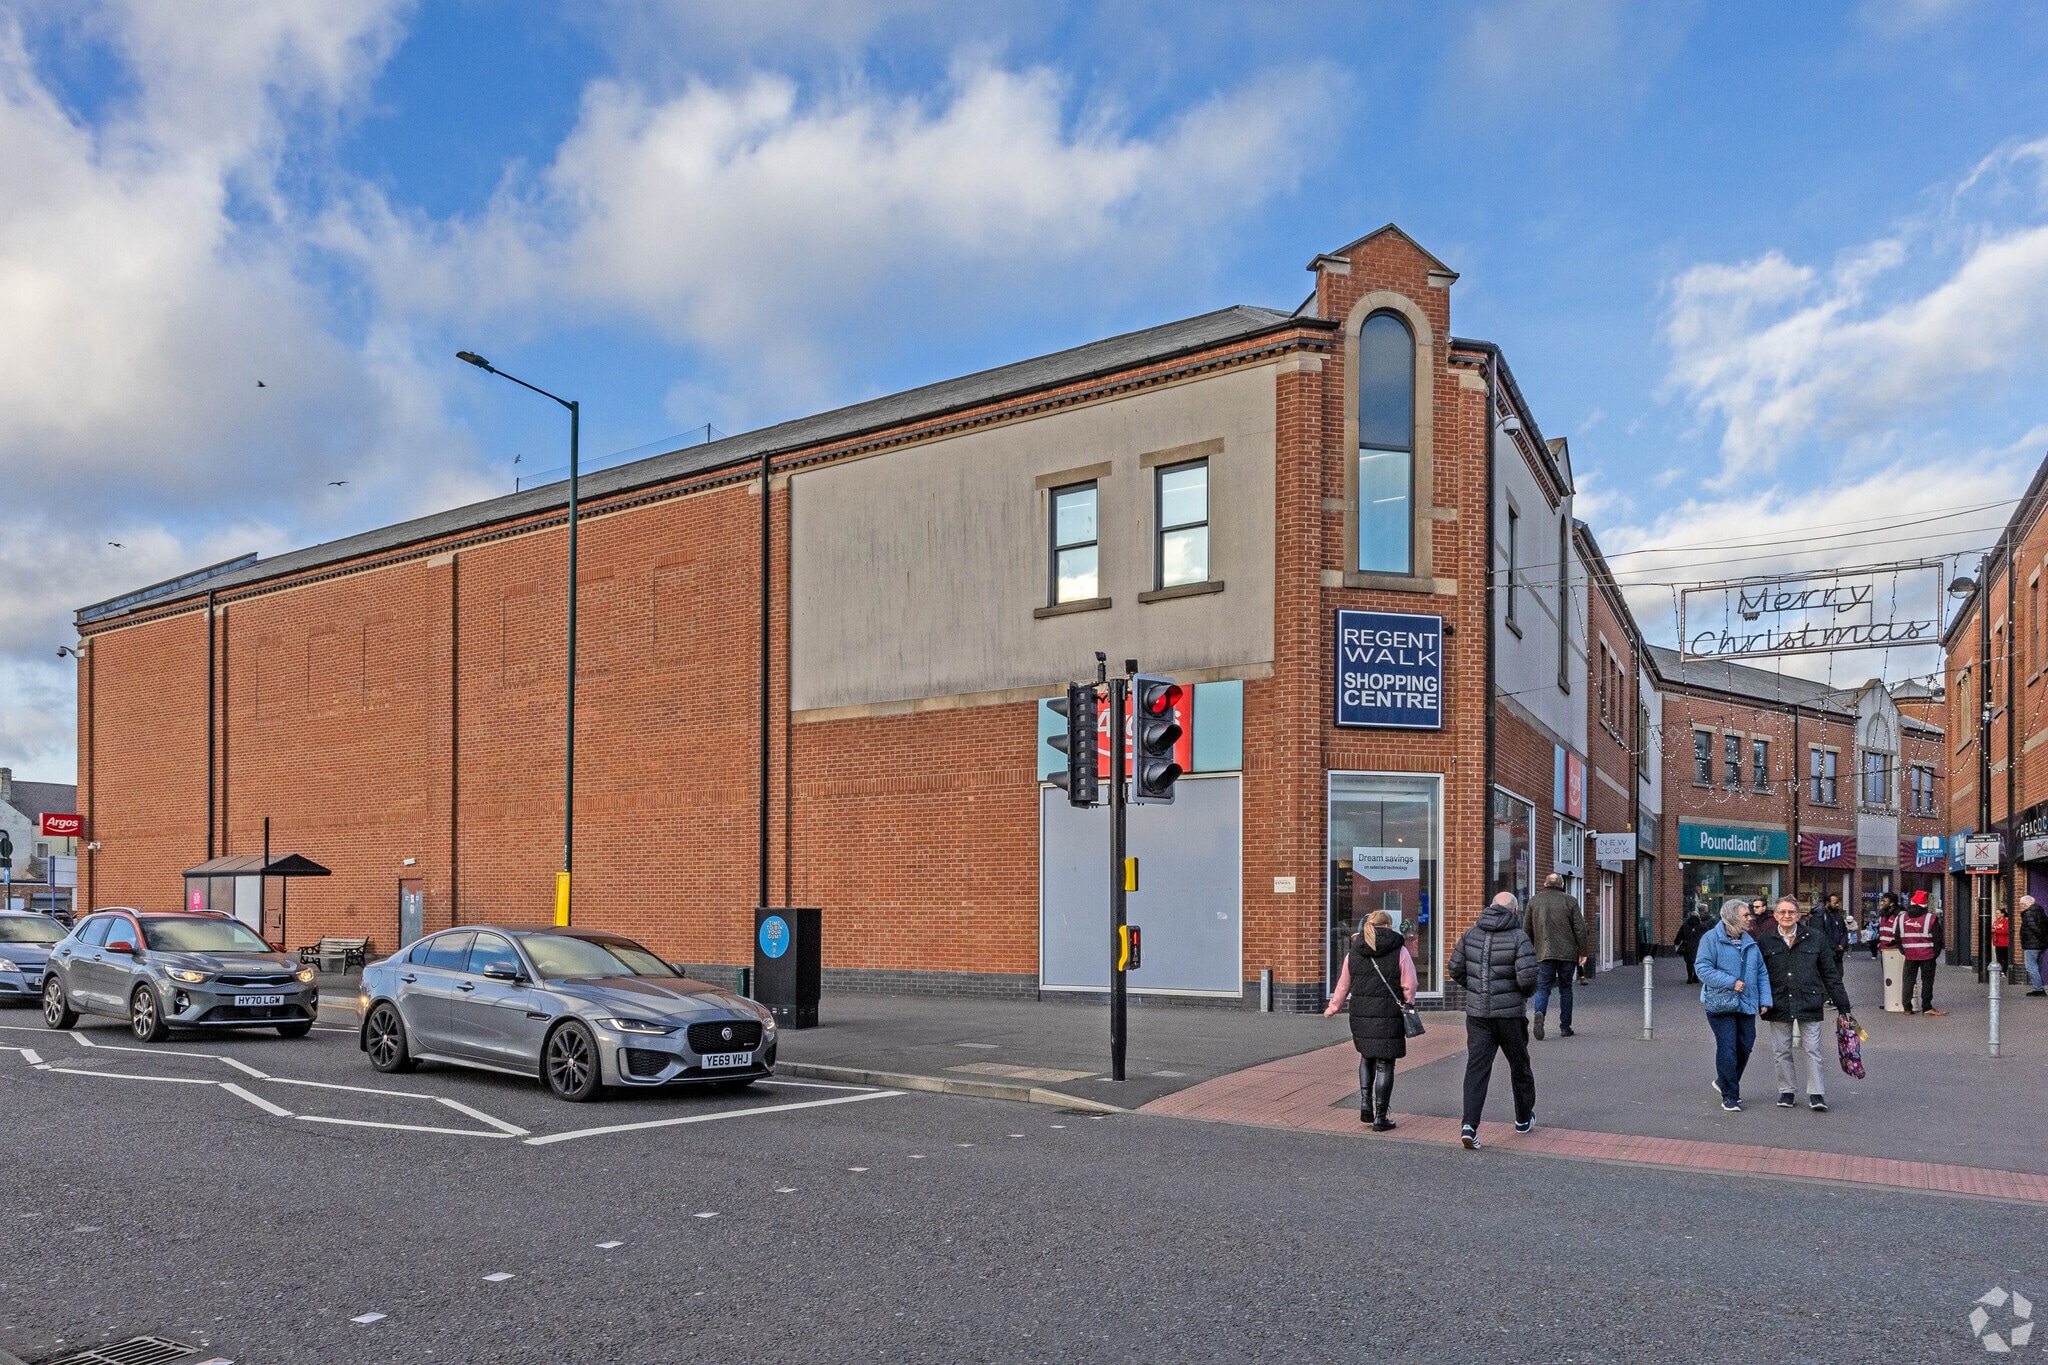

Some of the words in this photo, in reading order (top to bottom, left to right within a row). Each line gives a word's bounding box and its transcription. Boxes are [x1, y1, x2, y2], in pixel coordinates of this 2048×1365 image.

[1737, 584, 1871, 614] Merry
[1344, 628, 1438, 649] REGENT
[1691, 620, 1931, 657] Christmas
[1344, 646, 1437, 667] WALK
[1344, 672, 1438, 692] SHOPPING
[1343, 690, 1438, 710] CENTRE
[46, 817, 79, 829] Argos
[1597, 847, 1630, 855] LOOK
[1700, 831, 1757, 852] Poundland
[1358, 853, 1384, 862] Dream
[1384, 854, 1414, 864] savings
[238, 996, 262, 1005] HY70
[263, 996, 281, 1004] LGW
[706, 1054, 731, 1067] YE69
[732, 1053, 749, 1065] VHJ
